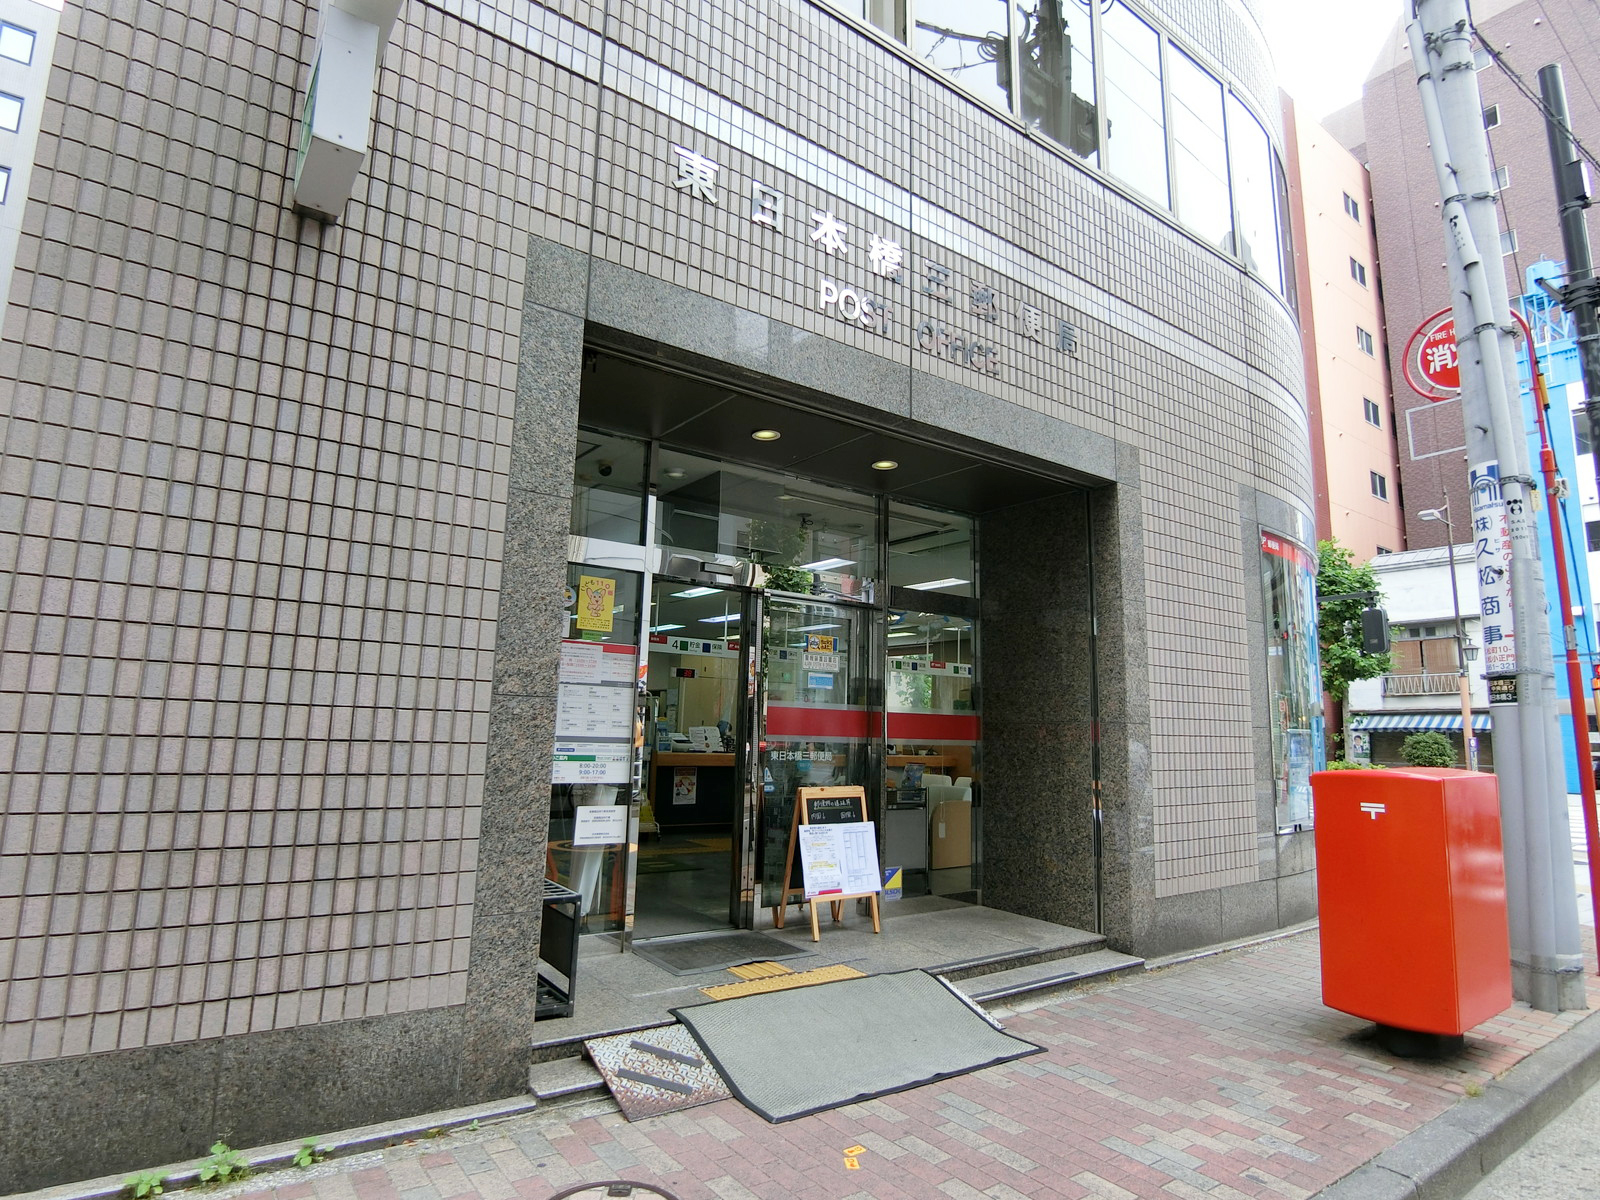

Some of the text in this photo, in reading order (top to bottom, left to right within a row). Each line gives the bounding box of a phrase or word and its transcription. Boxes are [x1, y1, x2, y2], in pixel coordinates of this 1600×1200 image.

[672, 145, 1079, 358] 東日本橋三郵便局
[819, 278, 1000, 377] POST OFFICE
[1430, 331, 1448, 343] FIRE
[671, 640, 679, 650] 4
[689, 641, 700, 649] 貯金
[770, 750, 833, 761] 東日本橋三郵便局
